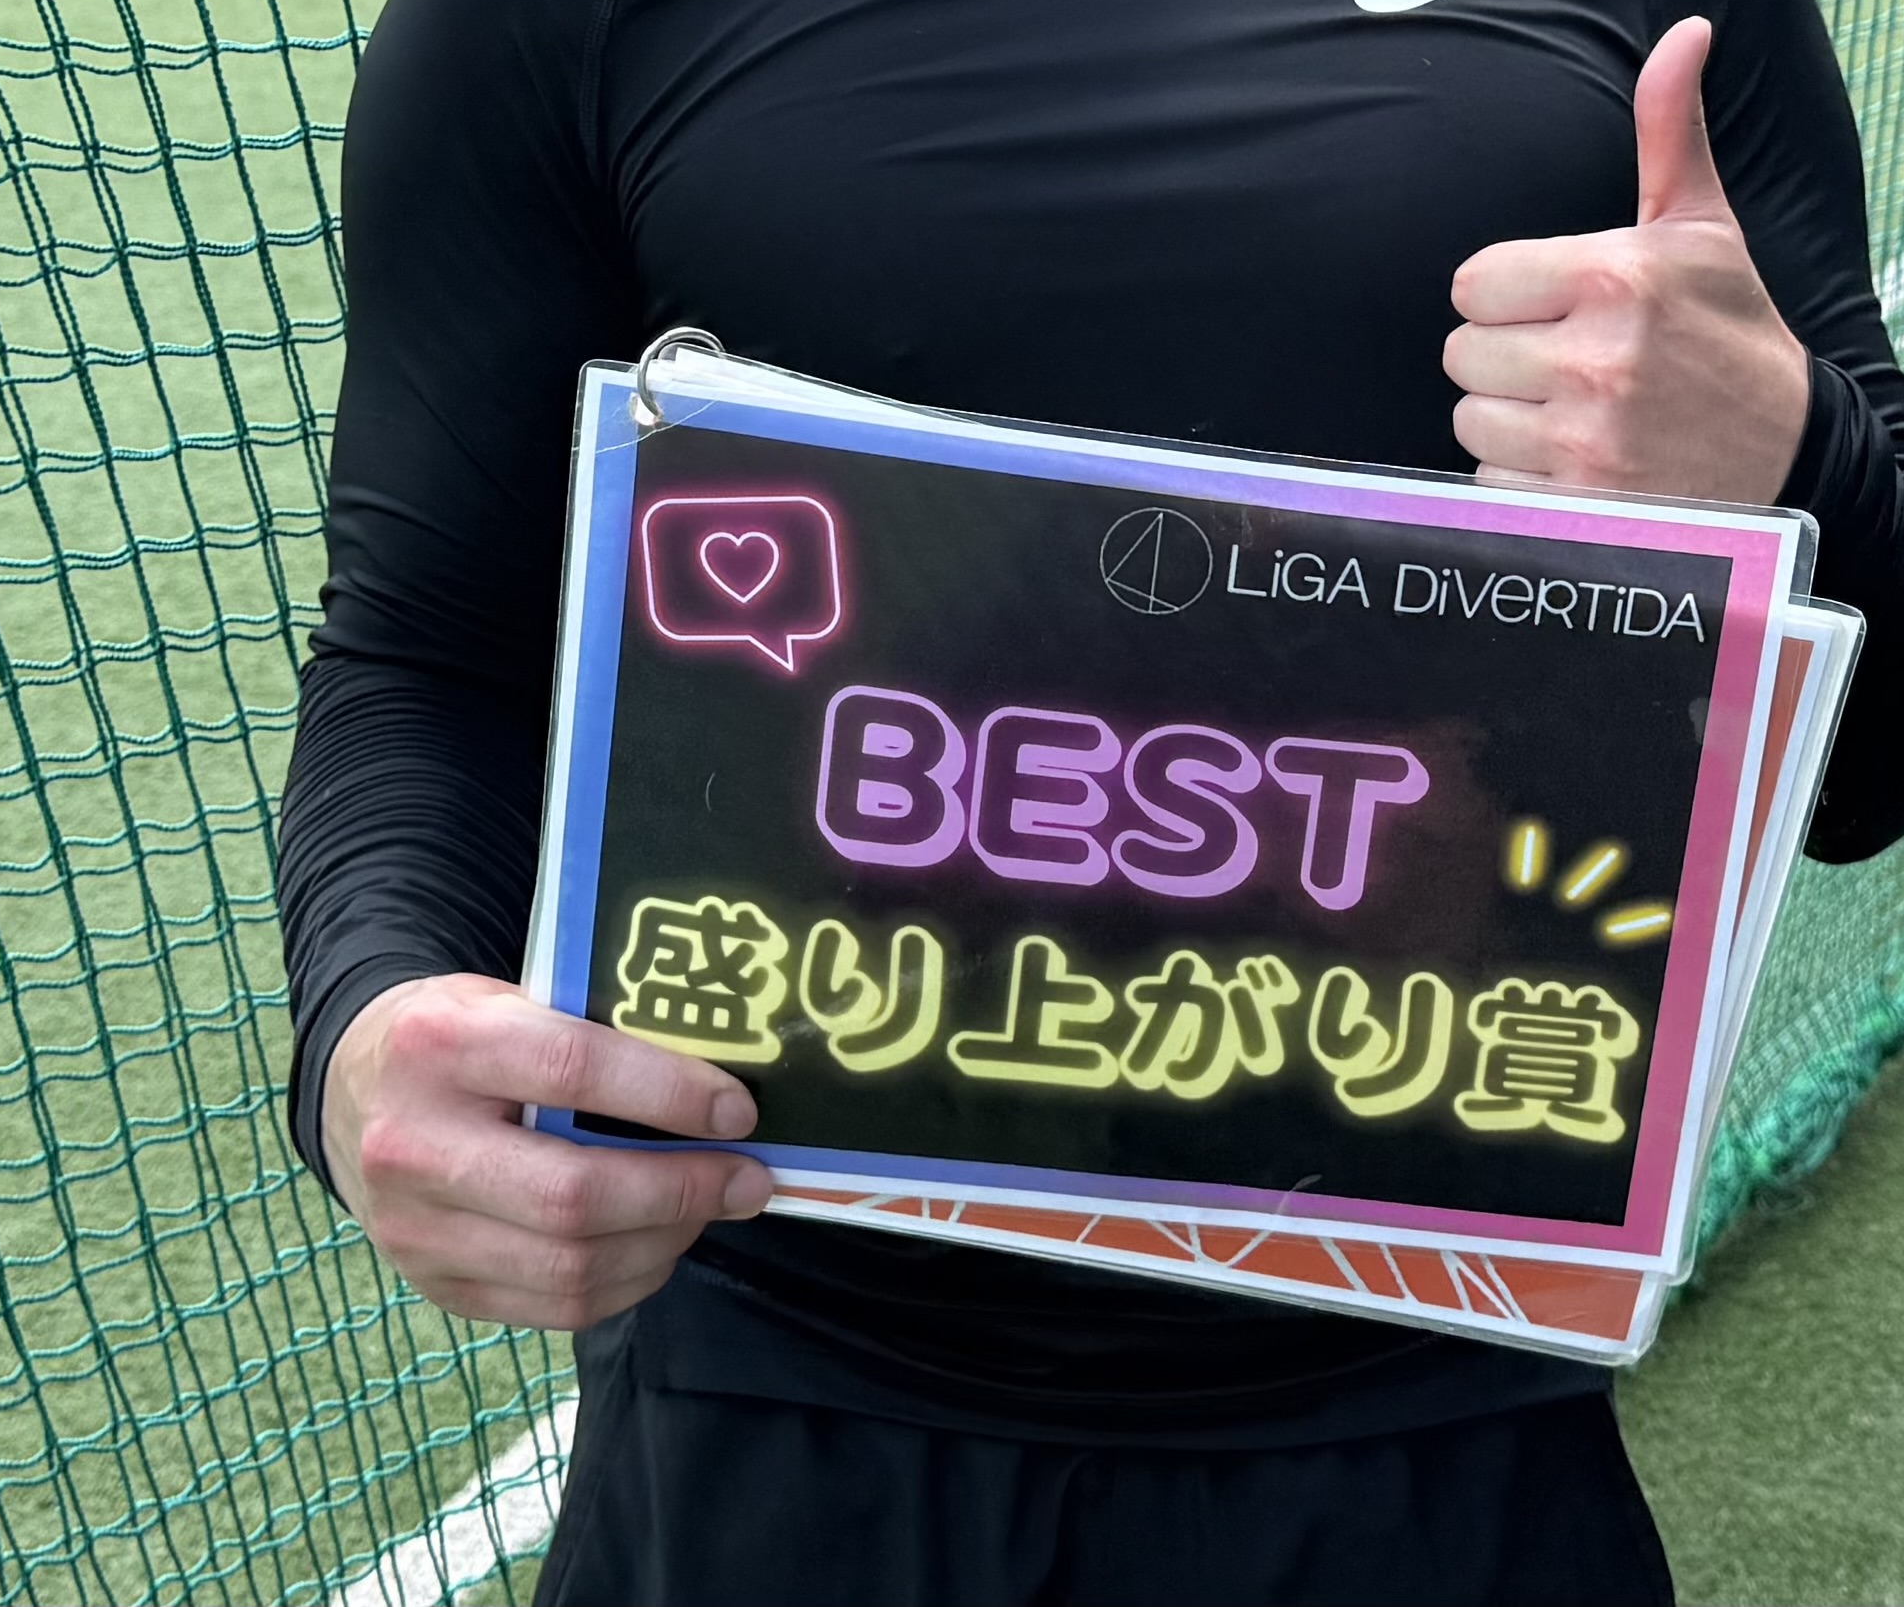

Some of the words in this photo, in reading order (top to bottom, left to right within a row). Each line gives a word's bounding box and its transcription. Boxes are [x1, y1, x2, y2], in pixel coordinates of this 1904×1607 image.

[814, 684, 1430, 911] BEST
[611, 895, 1641, 1144] 盛り上がり賞
